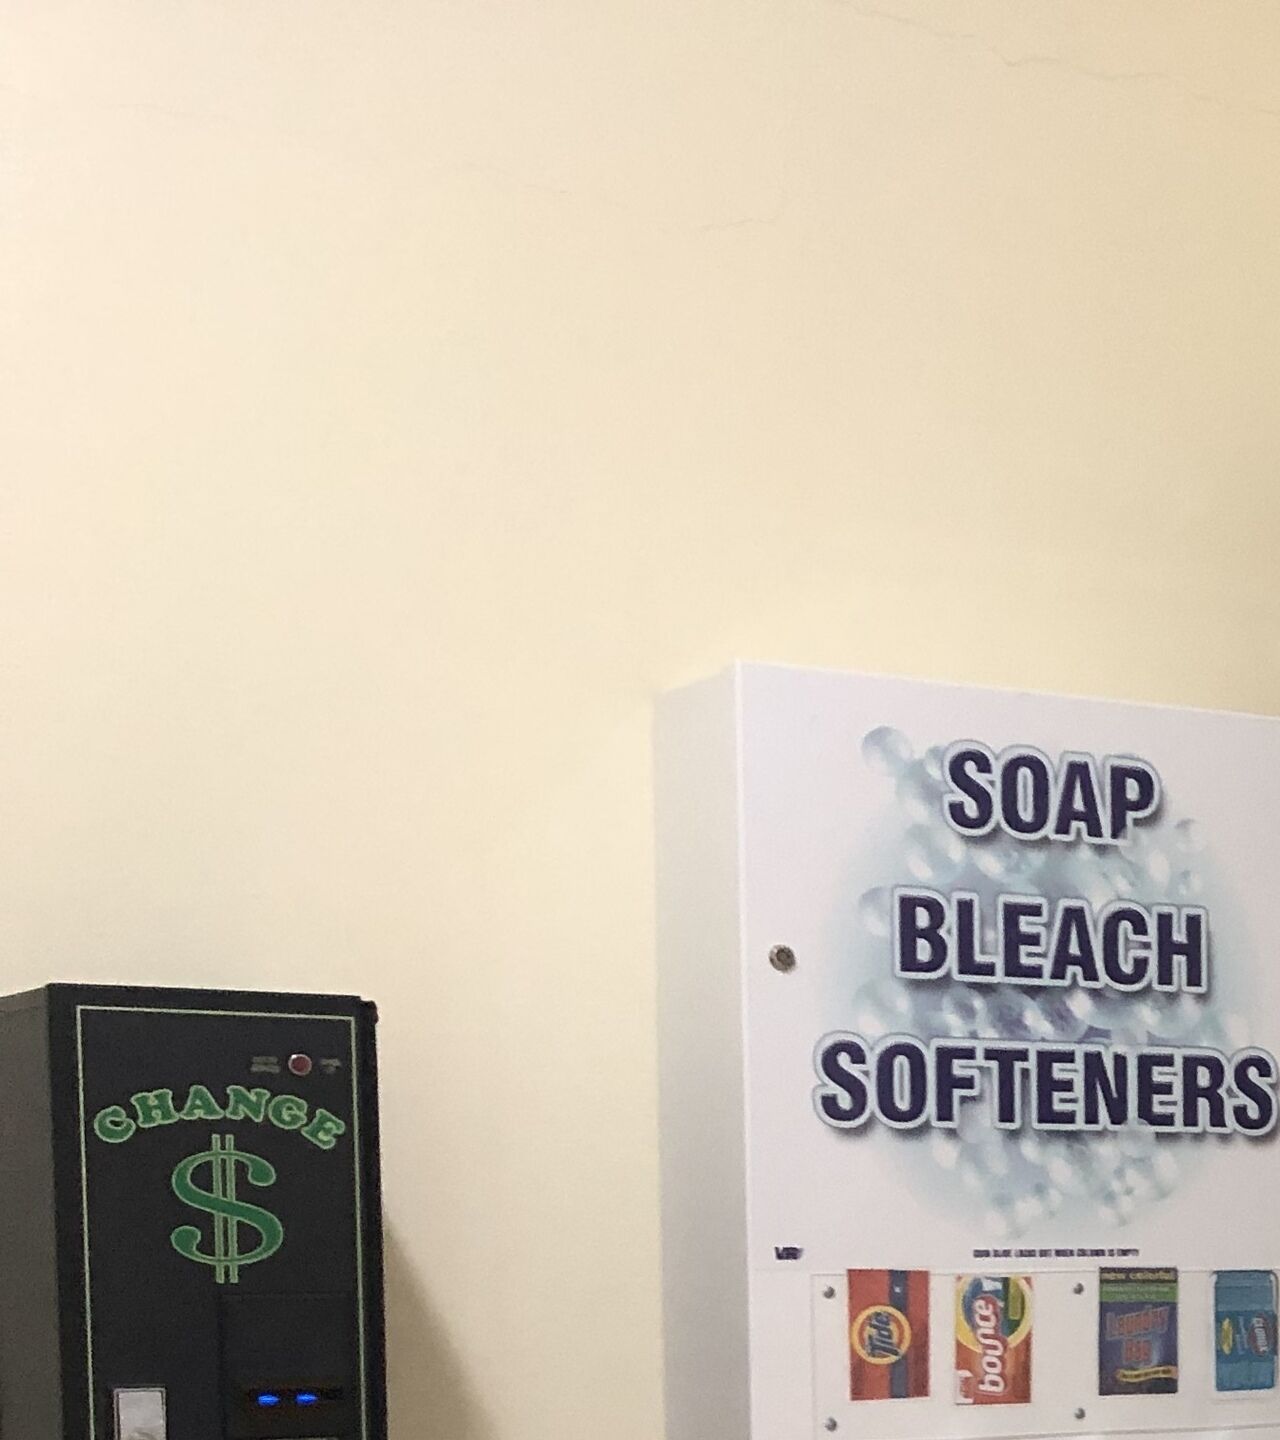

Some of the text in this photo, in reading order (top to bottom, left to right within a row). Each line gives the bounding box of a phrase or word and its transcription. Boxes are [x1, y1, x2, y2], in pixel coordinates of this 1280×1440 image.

[945, 746, 1157, 842] SOAP
[896, 891, 1206, 990] BLEACH
[94, 1085, 346, 1149] CHANGE
[817, 1037, 1276, 1132] SOFTENERS
[867, 1311, 900, 1358] Tide
[976, 1299, 1005, 1393] bounce
